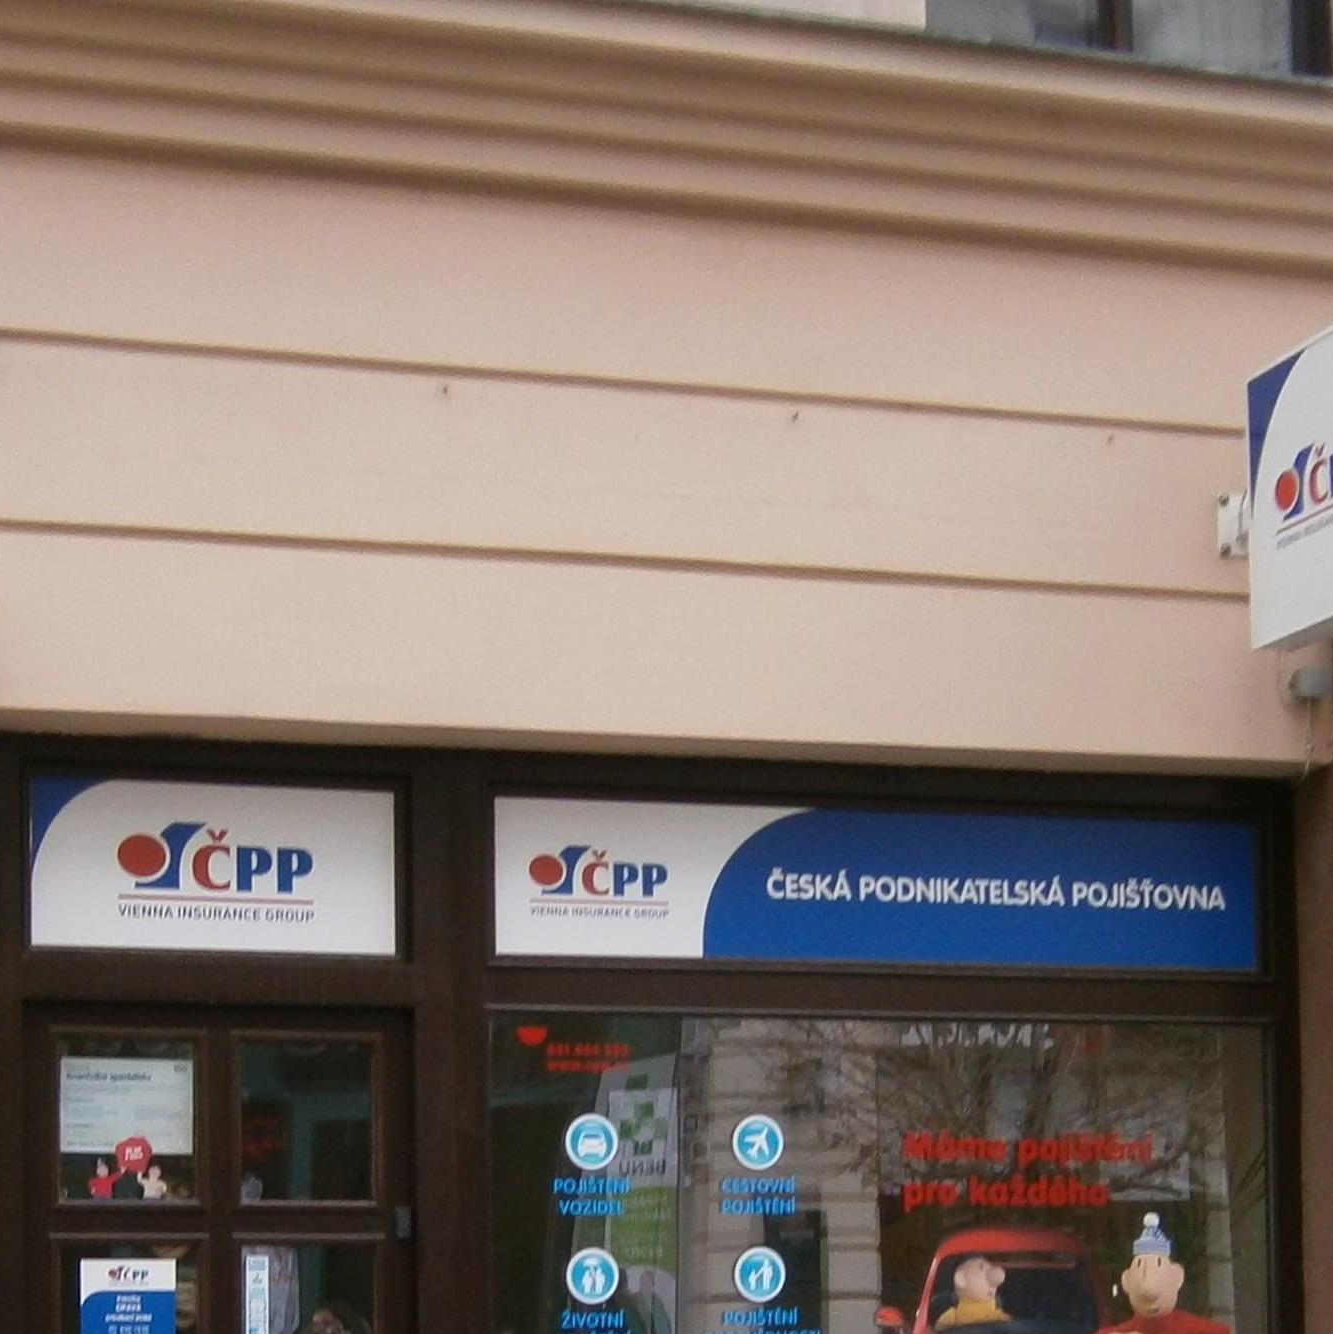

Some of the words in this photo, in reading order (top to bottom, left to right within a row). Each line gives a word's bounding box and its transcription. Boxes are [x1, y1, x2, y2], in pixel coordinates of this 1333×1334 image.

[191, 828, 314, 894] ČPP
[581, 849, 668, 897] ČPP
[766, 867, 852, 900] ČESKÁ
[859, 874, 1065, 907] PODNIKATELSKÁ
[1072, 878, 1225, 911] POJIŠŤOVNA
[118, 903, 173, 919] VIENNA
[177, 906, 260, 922] INSURANCE
[265, 909, 315, 924] GROUP
[902, 1130, 1008, 1163] Máme
[901, 1182, 959, 1213] pro
[970, 1174, 1111, 1207] každého
